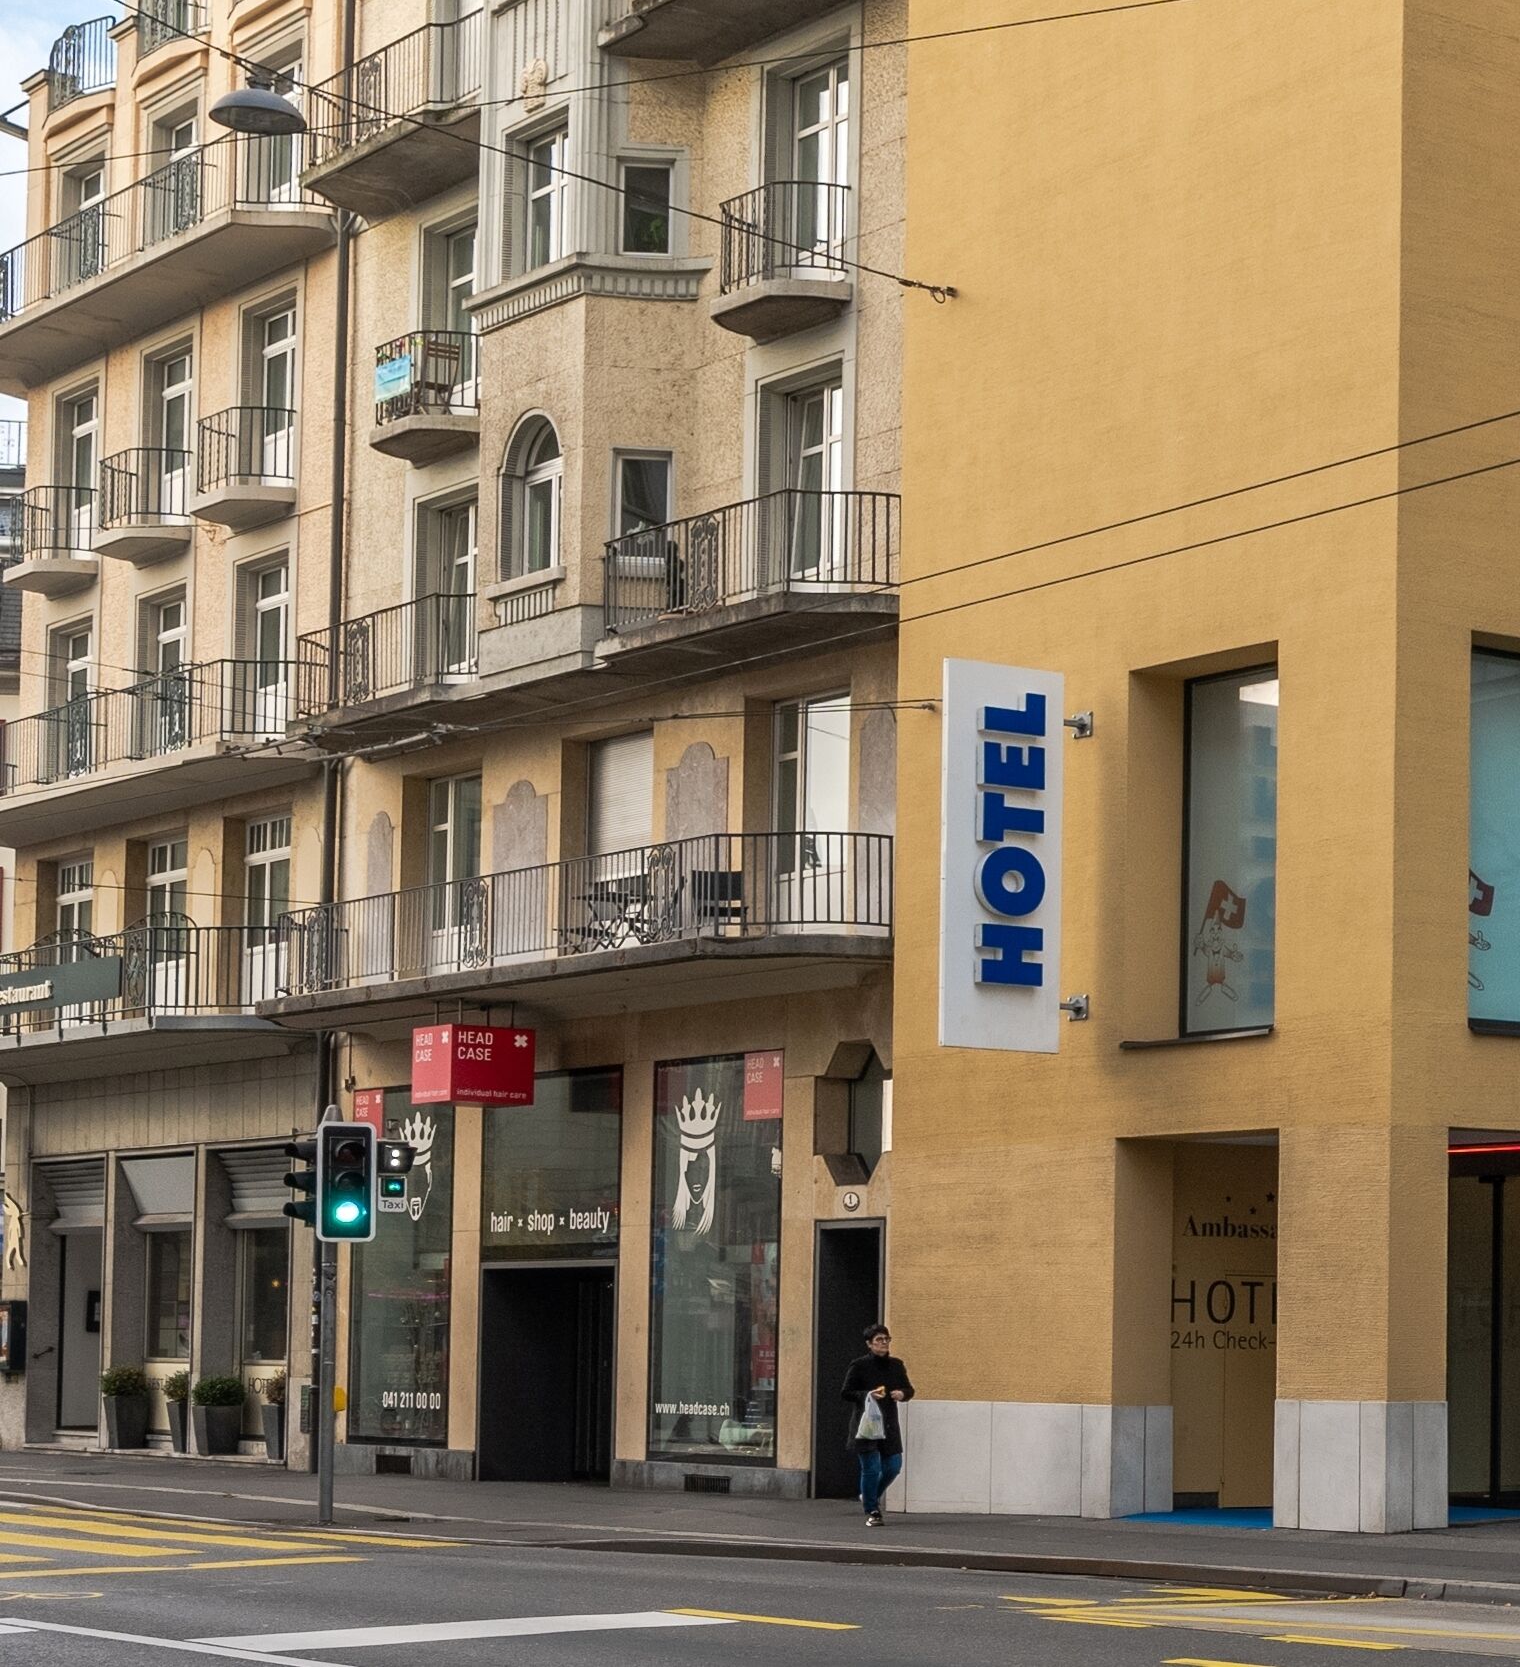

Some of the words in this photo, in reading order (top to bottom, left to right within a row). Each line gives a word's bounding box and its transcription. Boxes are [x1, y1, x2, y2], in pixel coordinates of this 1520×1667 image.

[976, 692, 1047, 988] HOTEL
[0, 979, 53, 1006] staurant
[416, 1032, 433, 1047] HEAD
[458, 1031, 494, 1046] HEAD
[415, 1048, 432, 1062] CASE
[457, 1047, 492, 1062] CASE
[747, 1057, 764, 1070] HEAD
[747, 1072, 764, 1084] CASE
[355, 1107, 369, 1118] CASE
[382, 1199, 404, 1209] Taxi
[490, 1211, 514, 1233] hair
[527, 1210, 555, 1235] shop
[569, 1207, 610, 1234] beauty
[1170, 1329, 1205, 1350] 24h
[382, 1391, 398, 1408] 041
[400, 1391, 414, 1409] 211
[416, 1392, 428, 1409] 00
[430, 1392, 441, 1410] 00
[655, 1400, 730, 1416] www.headcase.ch
